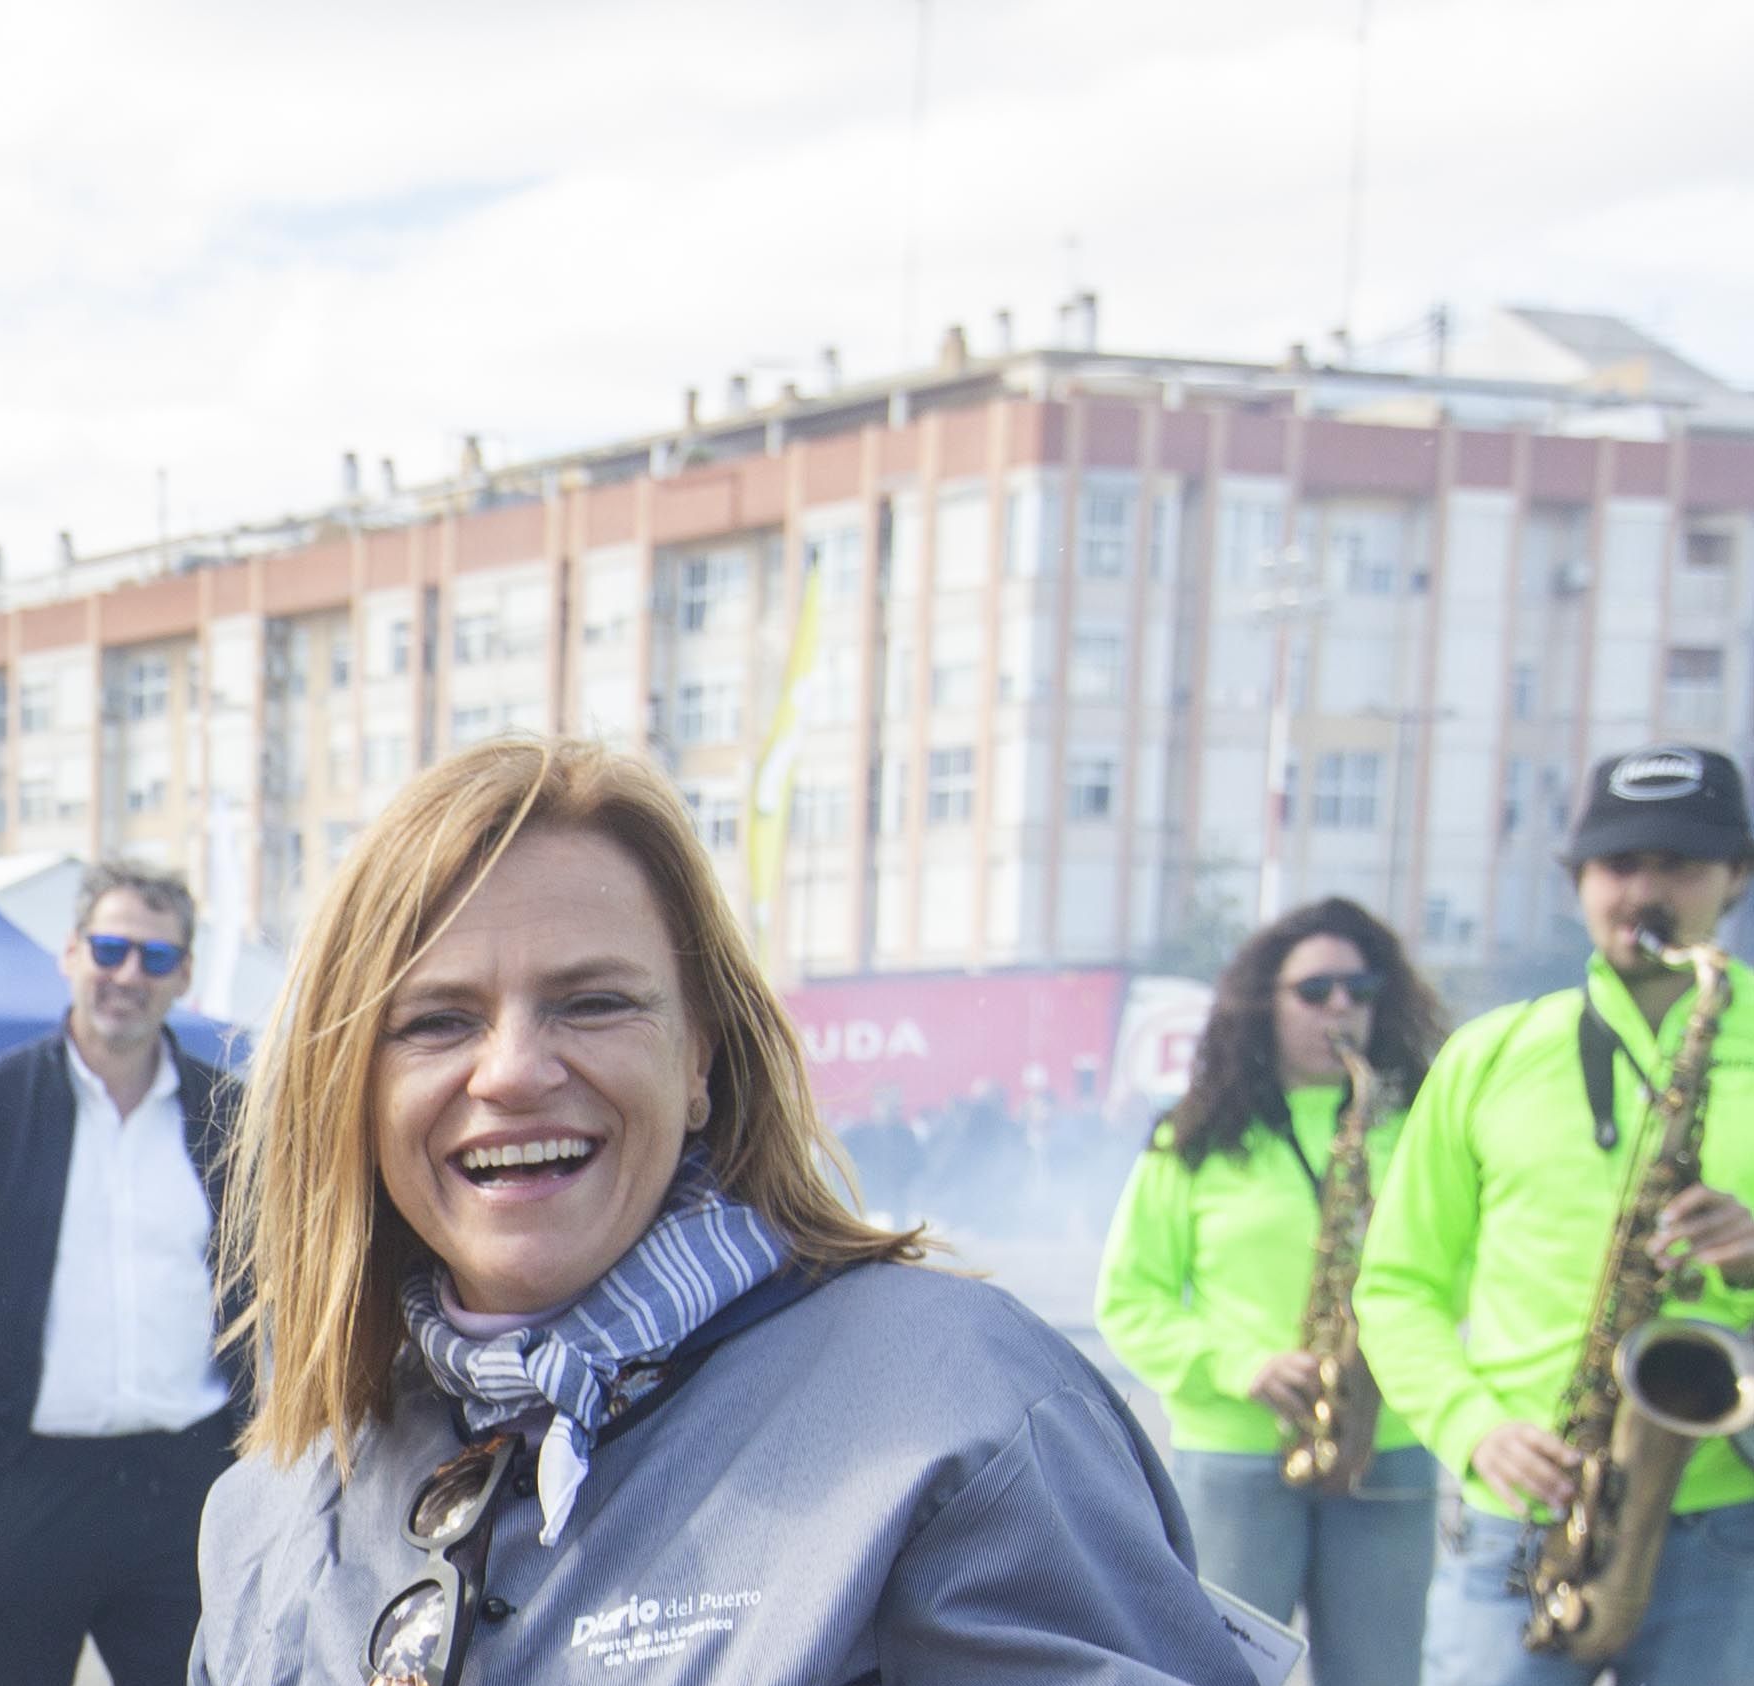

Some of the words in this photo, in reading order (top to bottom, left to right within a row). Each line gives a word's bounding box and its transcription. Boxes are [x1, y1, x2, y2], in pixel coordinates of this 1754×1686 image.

[571, 1594, 659, 1648] Diario
[665, 1597, 693, 1619] del
[699, 1590, 762, 1612] Puerto
[634, 1632, 653, 1648] de
